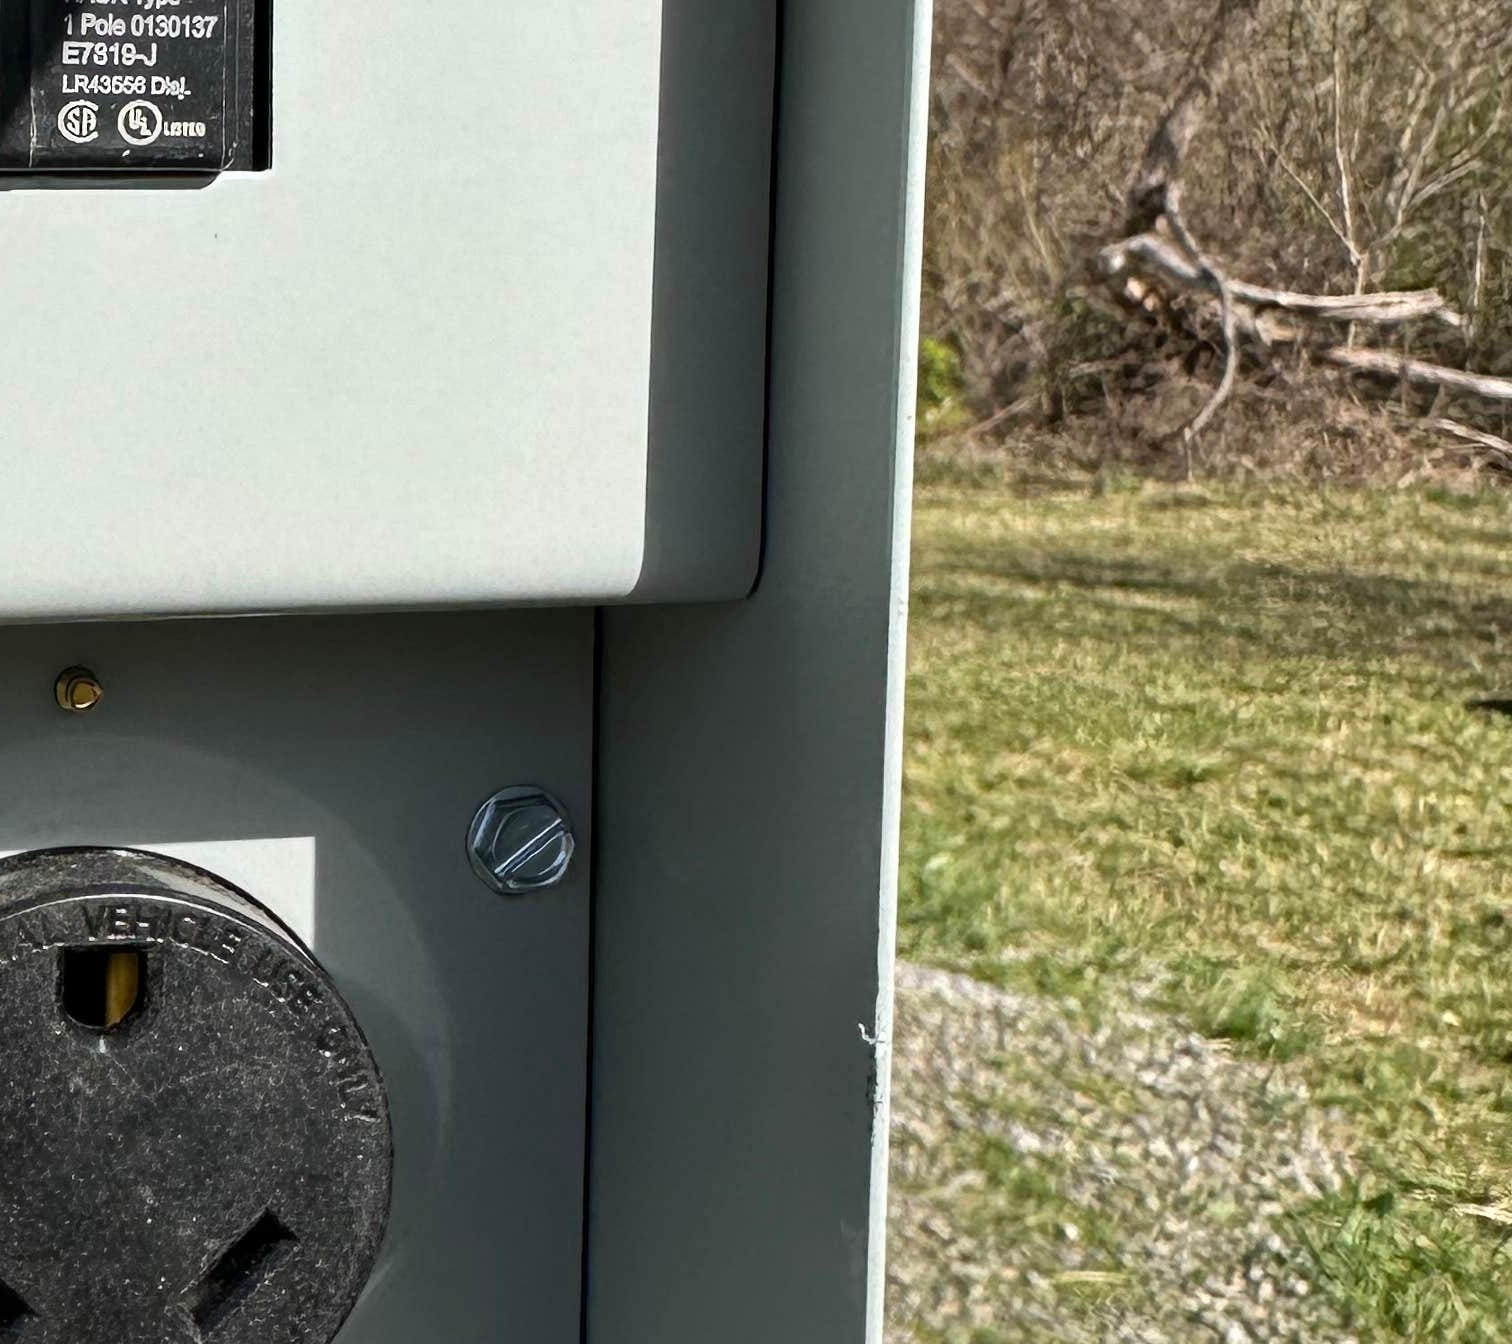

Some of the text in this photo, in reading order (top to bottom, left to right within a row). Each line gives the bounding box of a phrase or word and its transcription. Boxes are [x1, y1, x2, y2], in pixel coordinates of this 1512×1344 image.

[63, 12, 219, 39] 1 Pole 0130137
